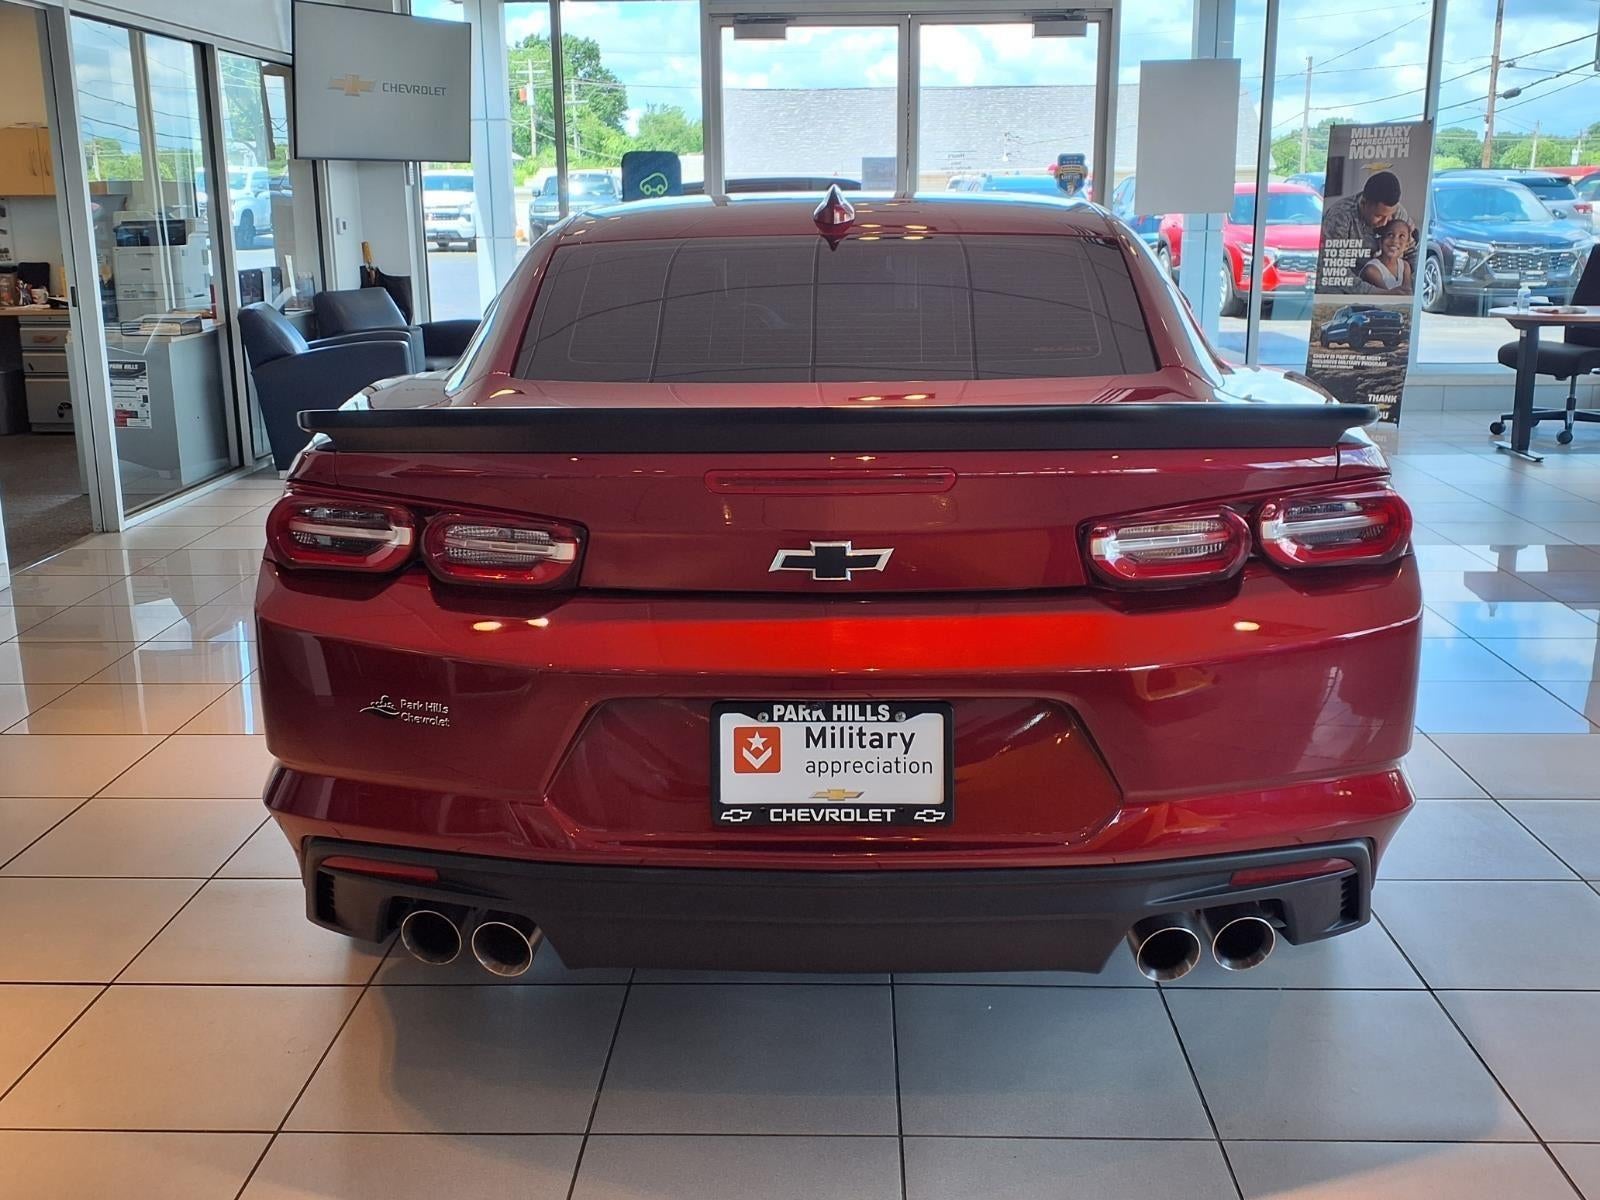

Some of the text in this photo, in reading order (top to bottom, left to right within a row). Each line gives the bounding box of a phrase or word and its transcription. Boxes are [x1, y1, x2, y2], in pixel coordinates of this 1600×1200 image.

[382, 82, 447, 96] CHEVROLET
[1350, 126, 1412, 139] MILITARY
[1350, 137, 1410, 146] APPRECIATION
[1348, 144, 1410, 160] MONTH
[1325, 239, 1363, 248] DRIVEN
[1324, 249, 1371, 258] TO SERVE
[1323, 258, 1357, 267] THOSE
[1322, 267, 1348, 277] WHO
[1321, 277, 1354, 286] SERVE
[1368, 394, 1397, 403] THANK
[400, 699, 449, 713] Park Hills
[773, 704, 890, 721] PARK HILLS
[400, 712, 450, 727] Chevrolet
[805, 726, 915, 755] Military
[805, 757, 933, 778] appreciation
[769, 808, 895, 822] CHEVROLET
